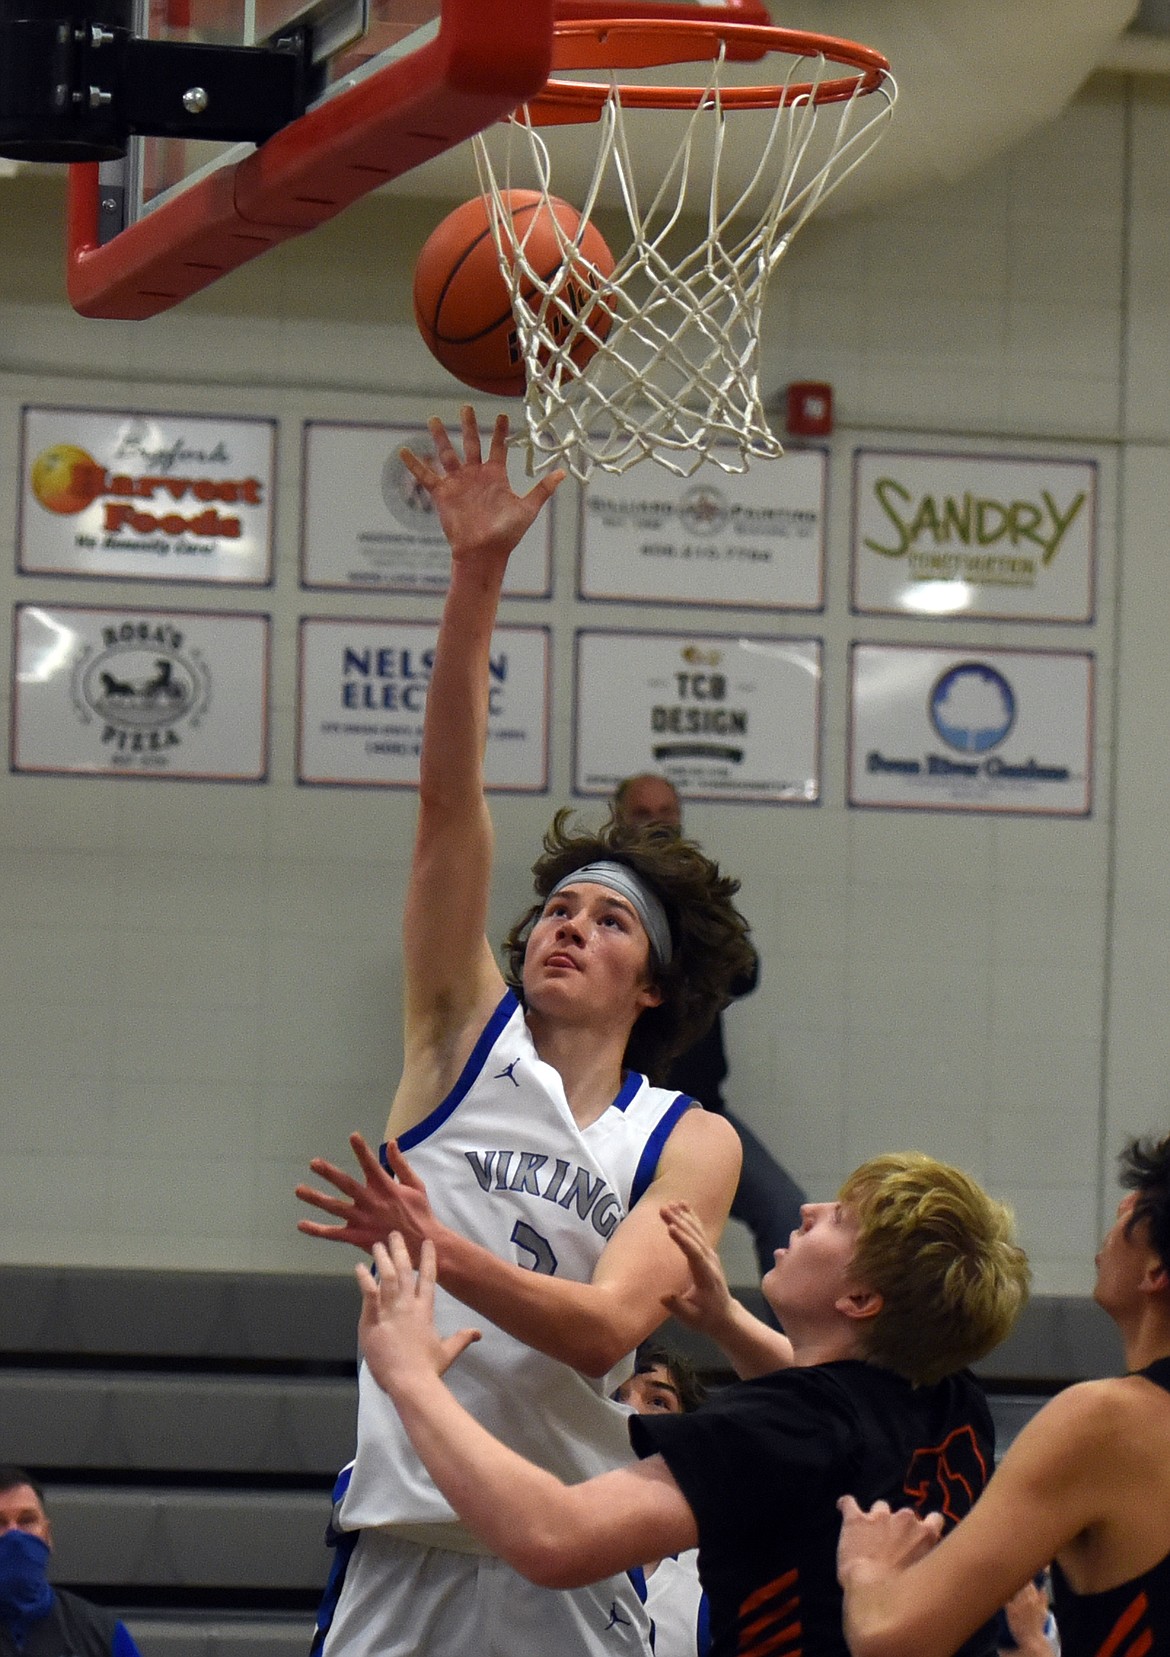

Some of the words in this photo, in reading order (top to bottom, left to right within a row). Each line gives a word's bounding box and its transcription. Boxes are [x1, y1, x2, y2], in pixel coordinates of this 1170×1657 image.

[104, 502, 242, 539] Foods
[863, 476, 1087, 566] SANDRY
[343, 646, 508, 683] NELSN
[341, 682, 504, 716] ELECC
[676, 671, 727, 700] TCB
[651, 705, 748, 735] DESIGN
[101, 725, 182, 752] PIZZA
[464, 1150, 622, 1241] VIKING
